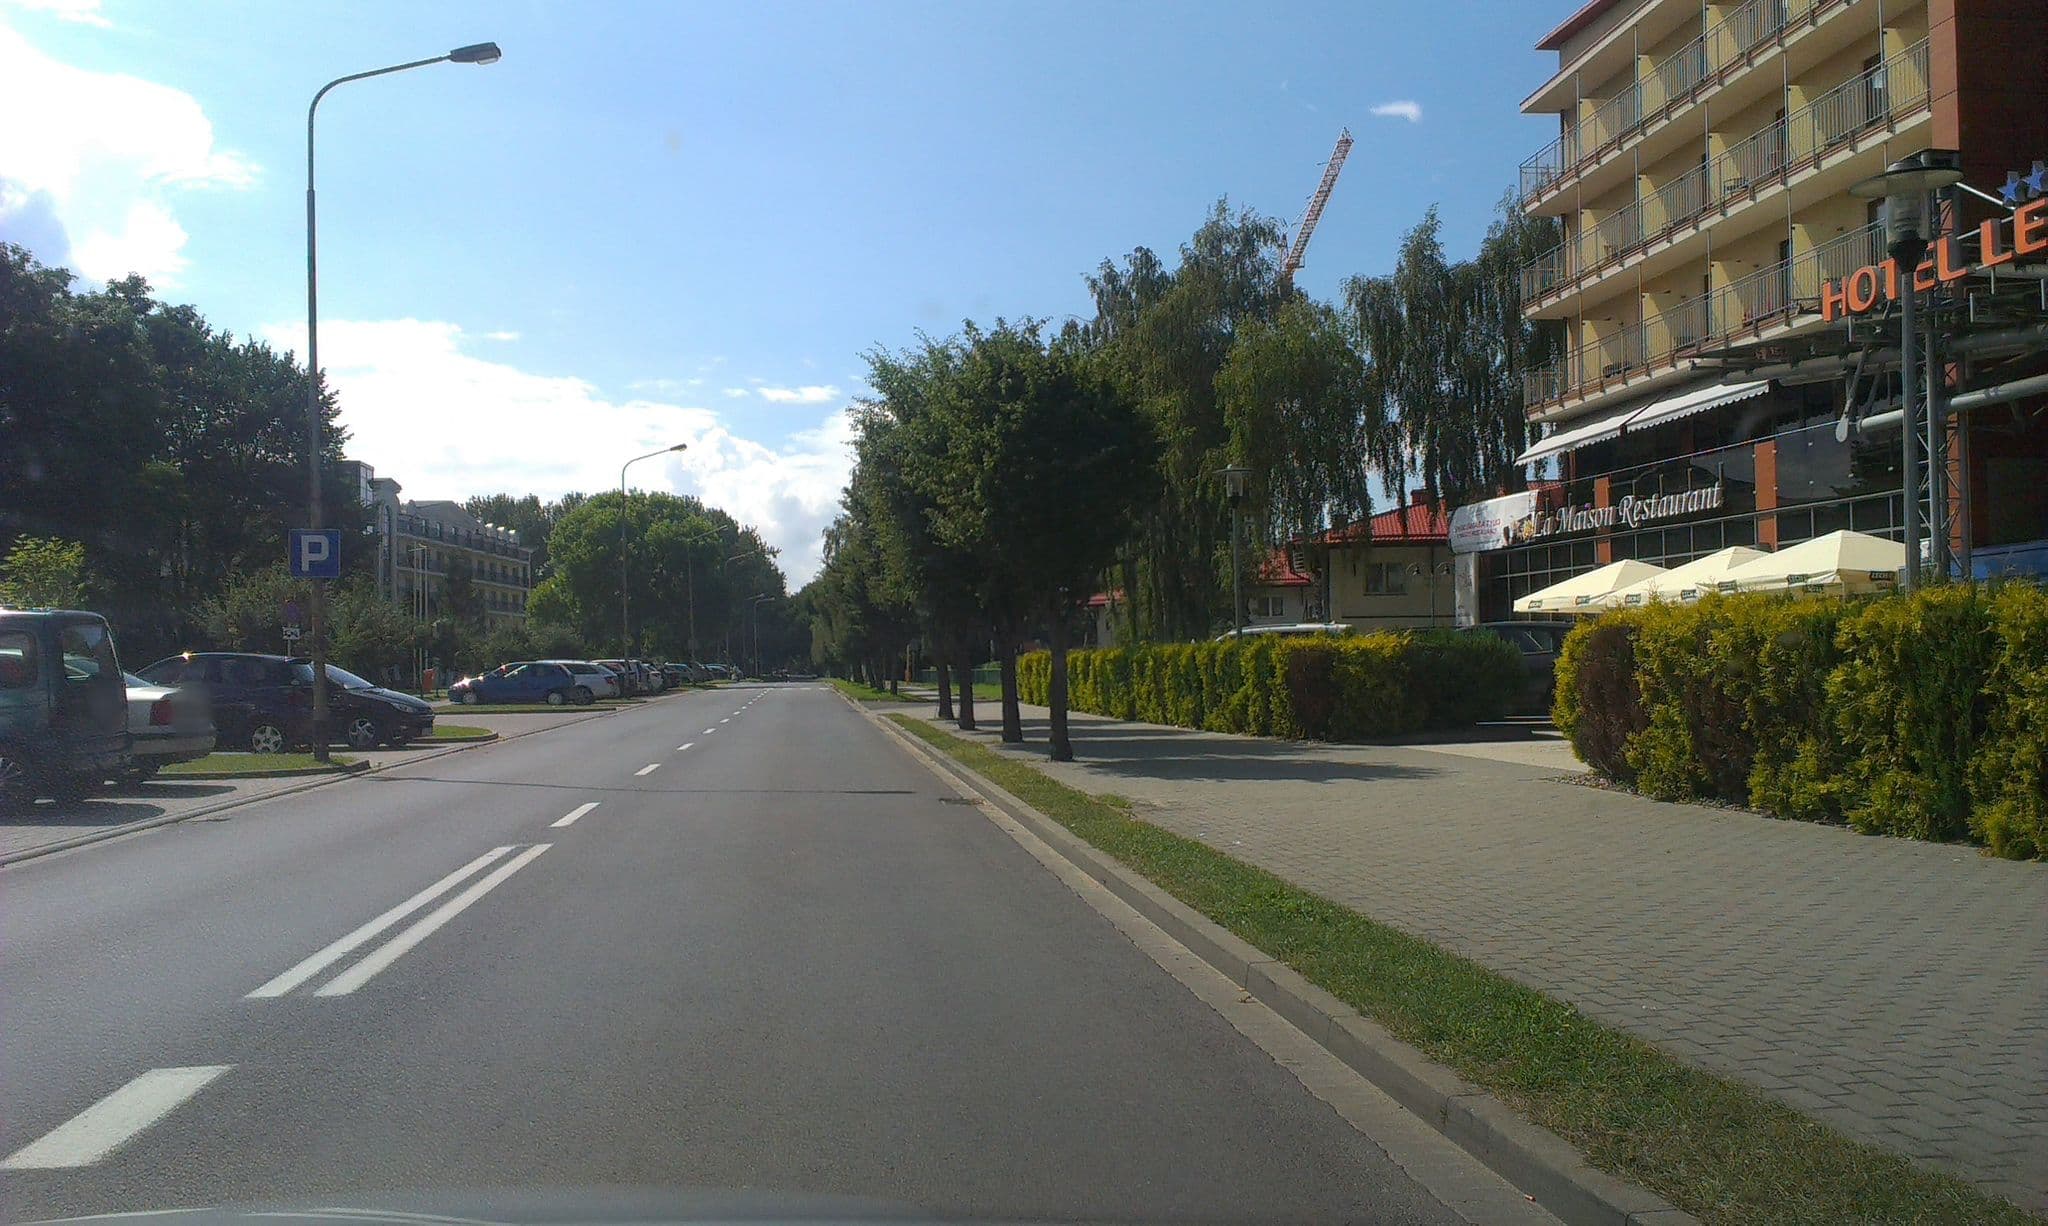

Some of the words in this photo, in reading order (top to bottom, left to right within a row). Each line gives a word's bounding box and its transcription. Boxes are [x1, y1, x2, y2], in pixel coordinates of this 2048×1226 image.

[1822, 236, 1969, 323] HOTEL
[1532, 511, 1552, 537] La
[1556, 504, 1617, 534] Maison
[1619, 481, 1722, 528] Restaurant
[301, 535, 329, 572] P
